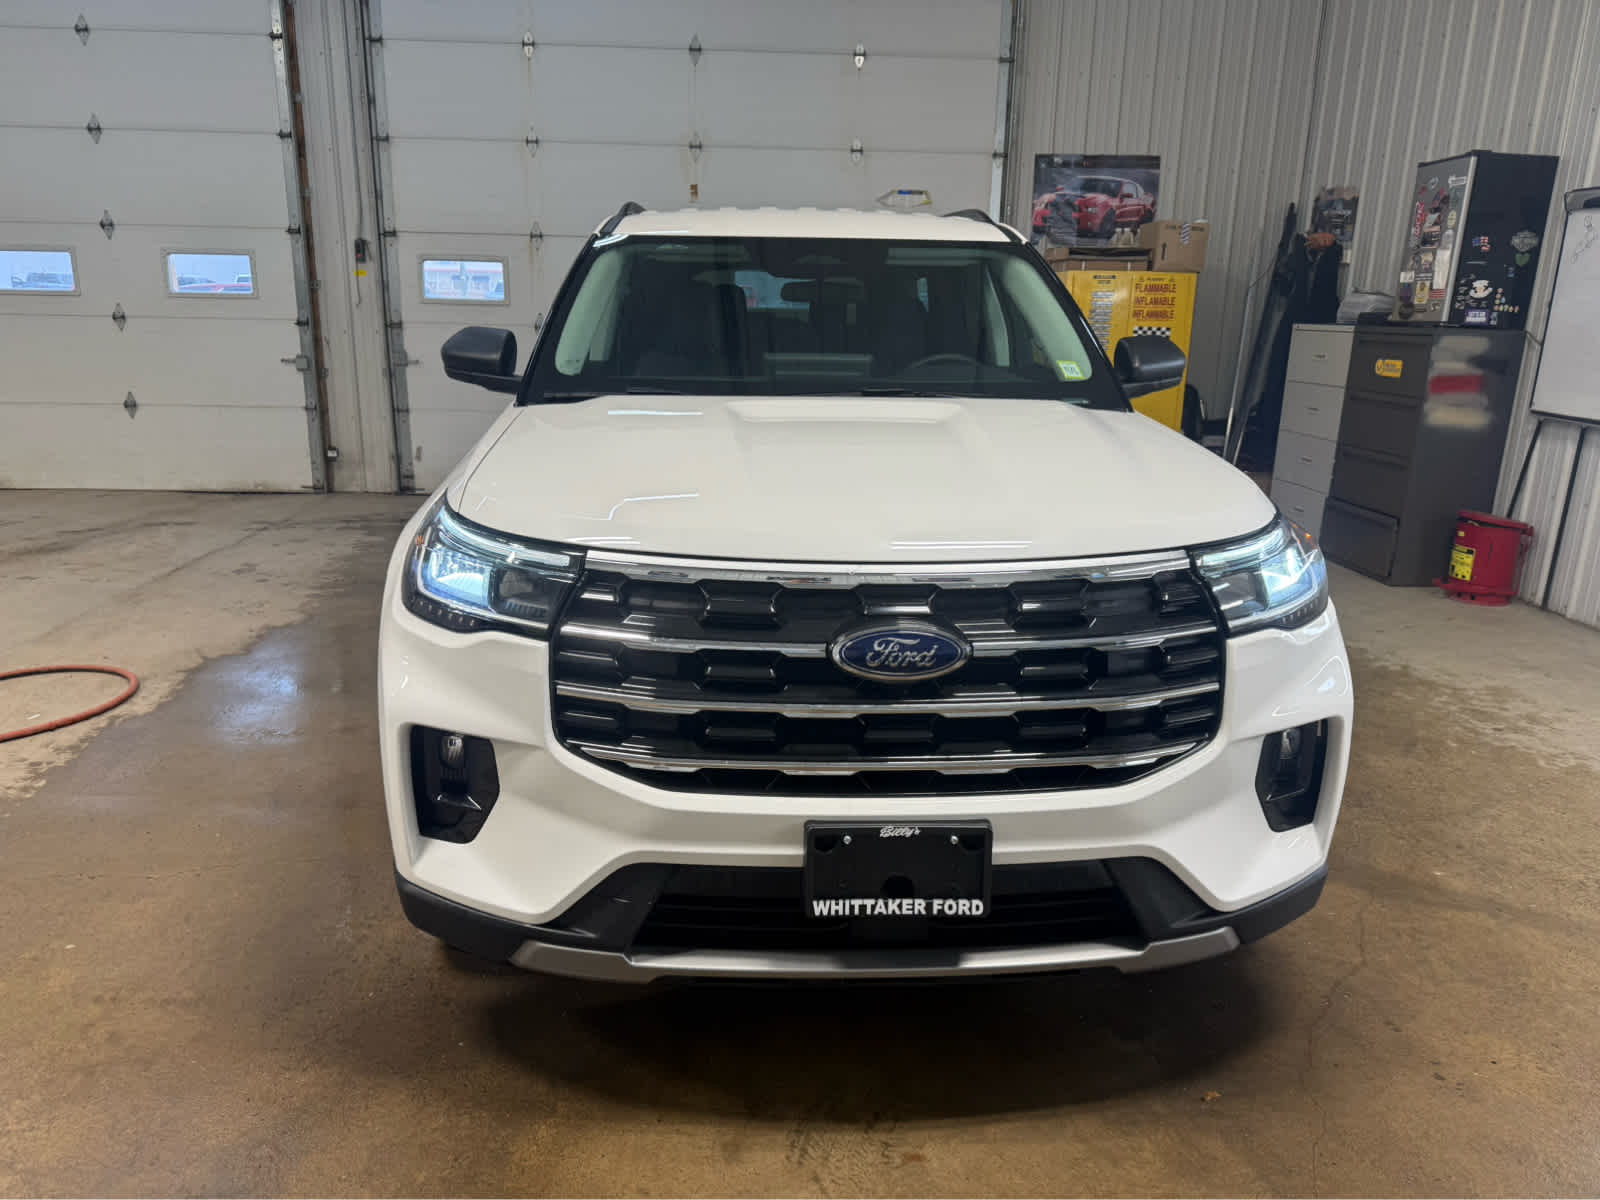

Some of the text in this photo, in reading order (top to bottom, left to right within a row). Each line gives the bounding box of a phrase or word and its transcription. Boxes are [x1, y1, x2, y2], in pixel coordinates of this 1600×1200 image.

[1135, 283, 1177, 293] FLAMMABLE
[866, 637, 938, 667] Ford
[811, 899, 984, 916] WHITTAKER FORD
